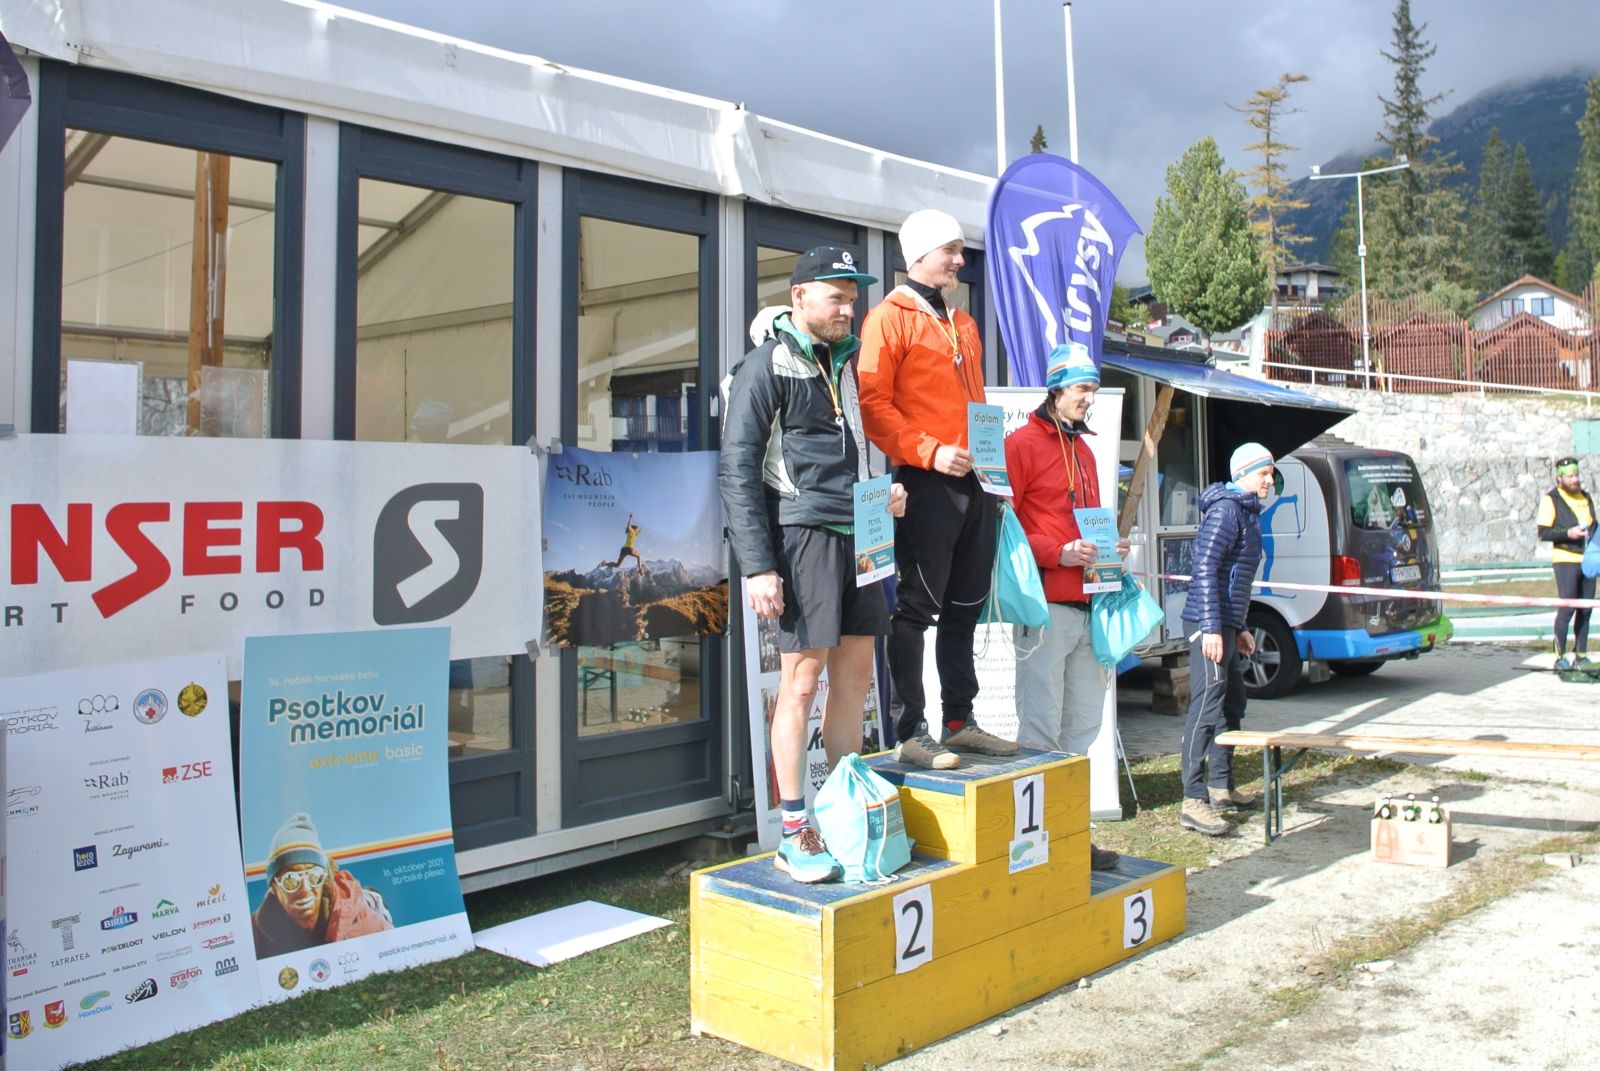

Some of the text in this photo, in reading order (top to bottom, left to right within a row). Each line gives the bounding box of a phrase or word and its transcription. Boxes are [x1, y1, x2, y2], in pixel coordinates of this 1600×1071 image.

[974, 411, 999, 425] diplom
[576, 464, 613, 487] Rab
[861, 488, 887, 503] diplom
[1083, 515, 1111, 527] diplom
[181, 588, 325, 614] FOOD
[268, 690, 386, 724] Psotkov
[289, 704, 424, 743] memoriál
[310, 743, 424, 769] extreme basic
[98, 771, 129, 789] Rab
[181, 760, 212, 781] ZSE
[1021, 780, 1040, 835] 1
[112, 837, 163, 860] Zagurami
[103, 914, 136, 929] BIRELL
[151, 906, 180, 920] MARVA
[1129, 896, 1147, 945] 3
[152, 927, 186, 941] VELON
[900, 899, 926, 960] 2
[50, 952, 91, 968] TATRATEA
[170, 967, 203, 988] grafon
[78, 1002, 113, 1020] HoreDole
